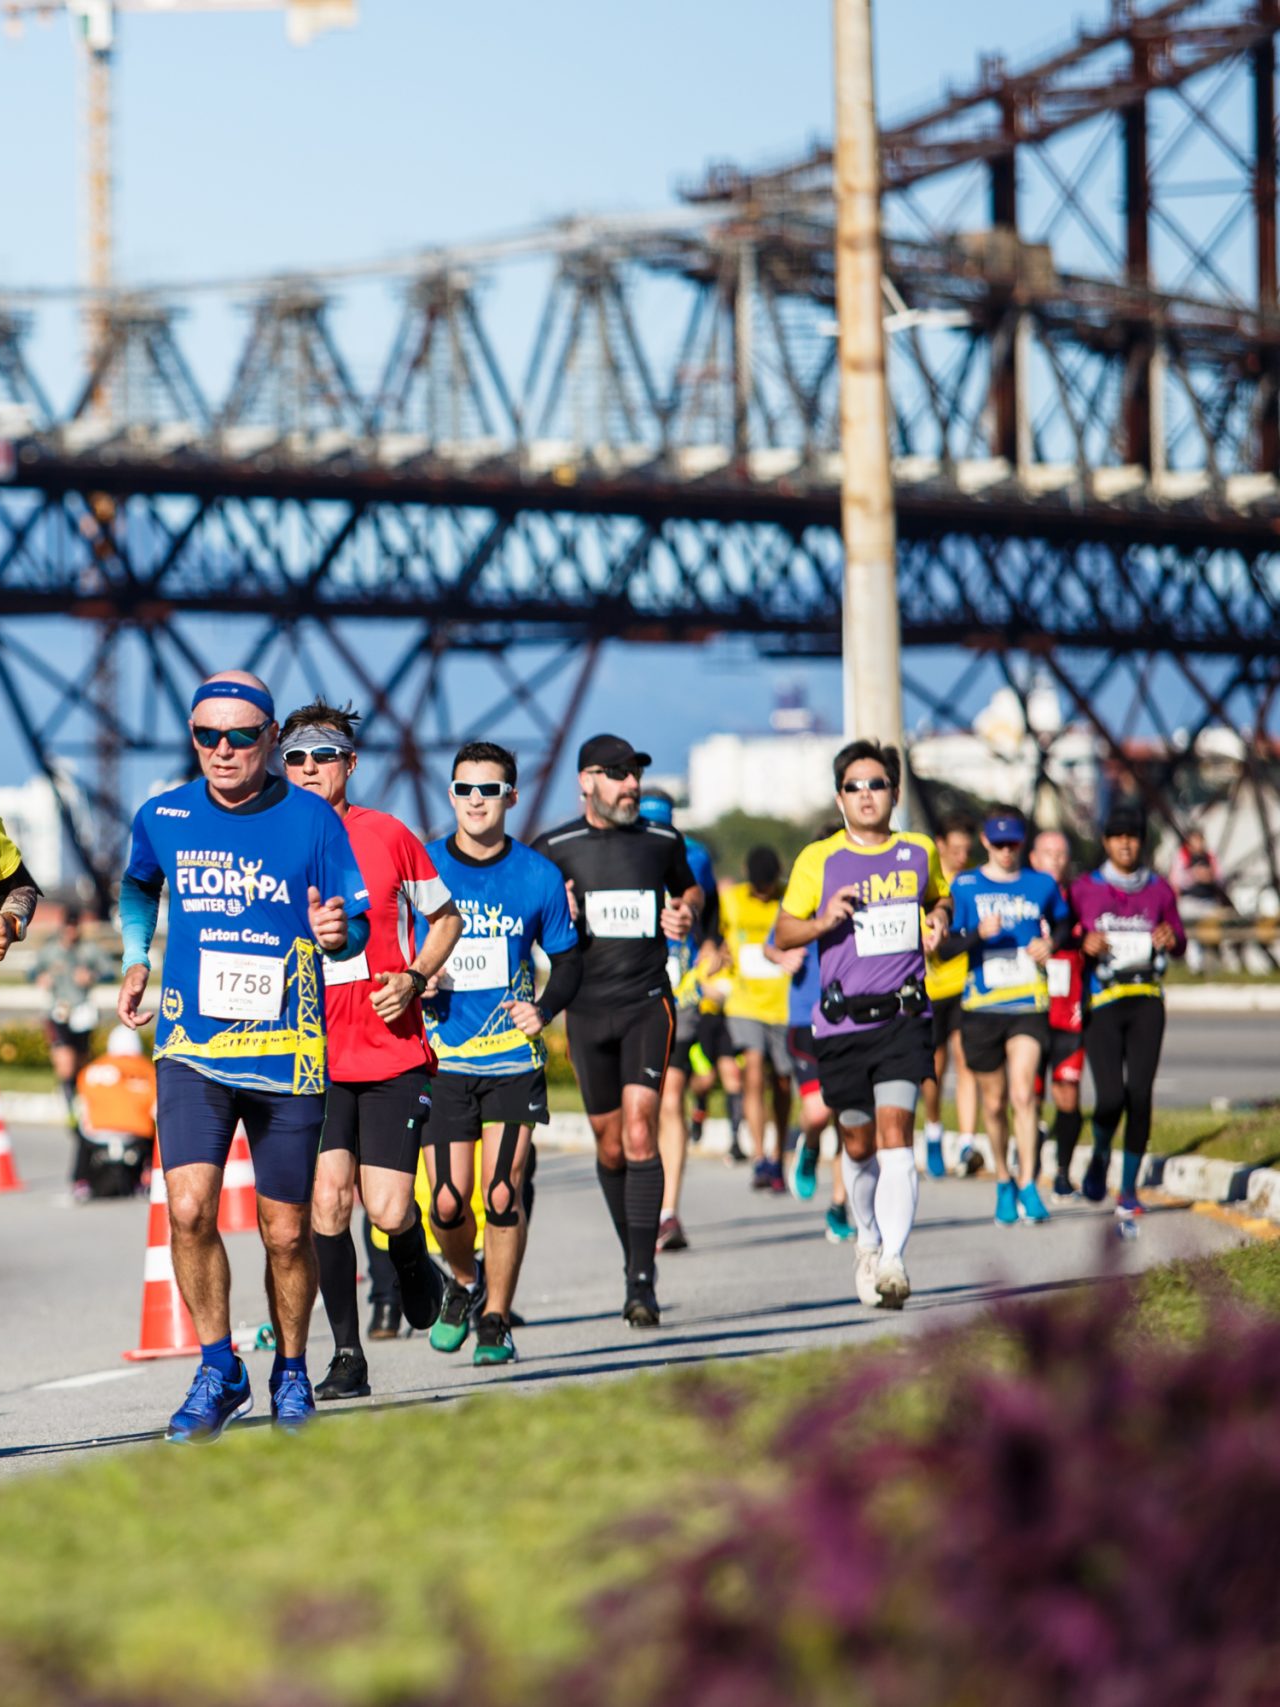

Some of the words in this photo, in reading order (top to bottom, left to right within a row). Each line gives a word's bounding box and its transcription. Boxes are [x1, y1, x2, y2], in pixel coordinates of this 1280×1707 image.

[176, 850, 233, 861] MARATONA
[601, 905, 640, 921] 1108
[199, 928, 240, 942] Airton
[241, 928, 280, 946] Carlos
[452, 955, 487, 971] 900
[216, 971, 271, 995] 1758
